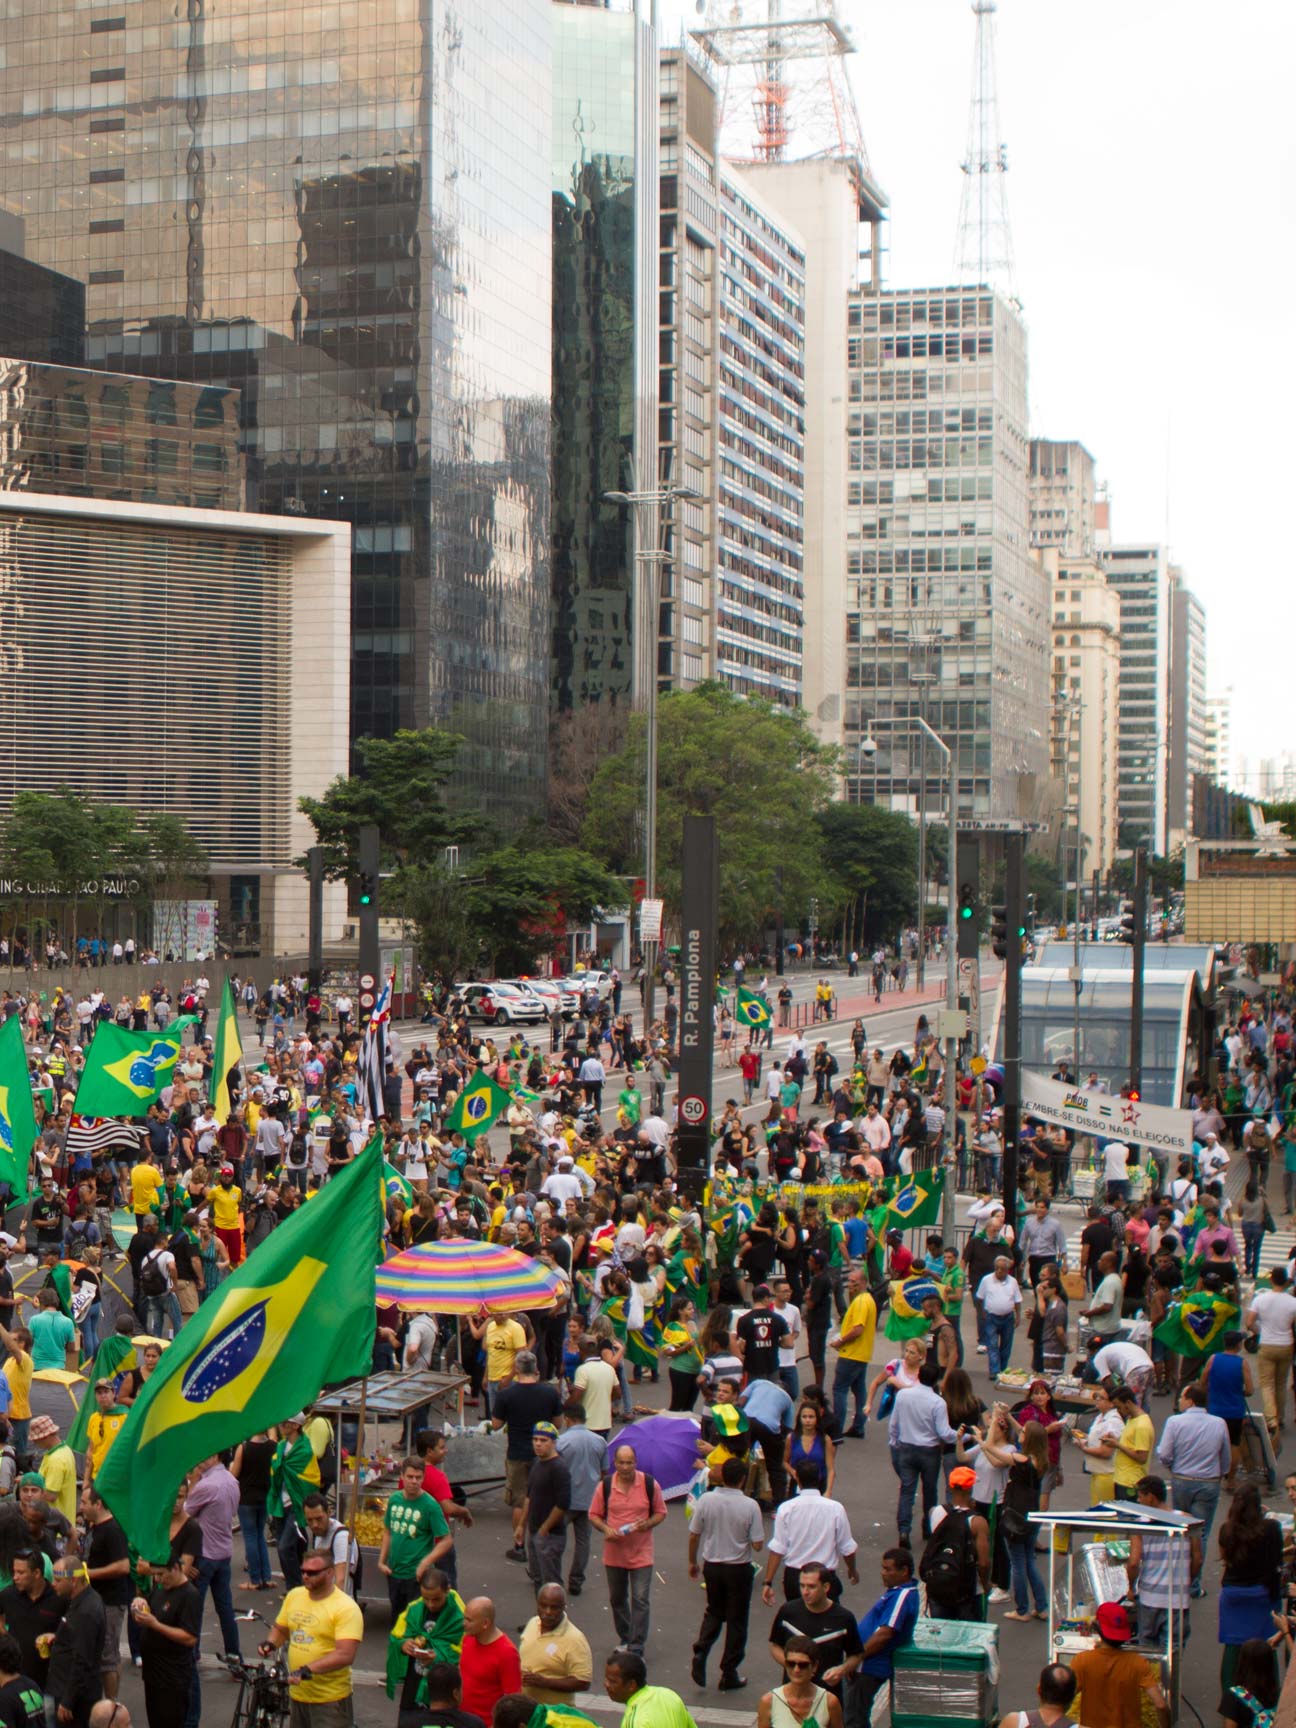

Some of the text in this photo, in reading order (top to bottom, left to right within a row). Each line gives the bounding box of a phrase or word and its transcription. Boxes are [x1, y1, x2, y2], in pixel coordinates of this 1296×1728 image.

[684, 929, 702, 1047] R. Pamplona
[685, 1102, 702, 1114] 50
[1065, 1091, 1089, 1106] PMDB
[1124, 1110, 1138, 1122] PT
[1076, 1114, 1106, 1131] DISSO
[1108, 1123, 1130, 1137] NAS
[1132, 1129, 1186, 1148] ELEIÇÕES
